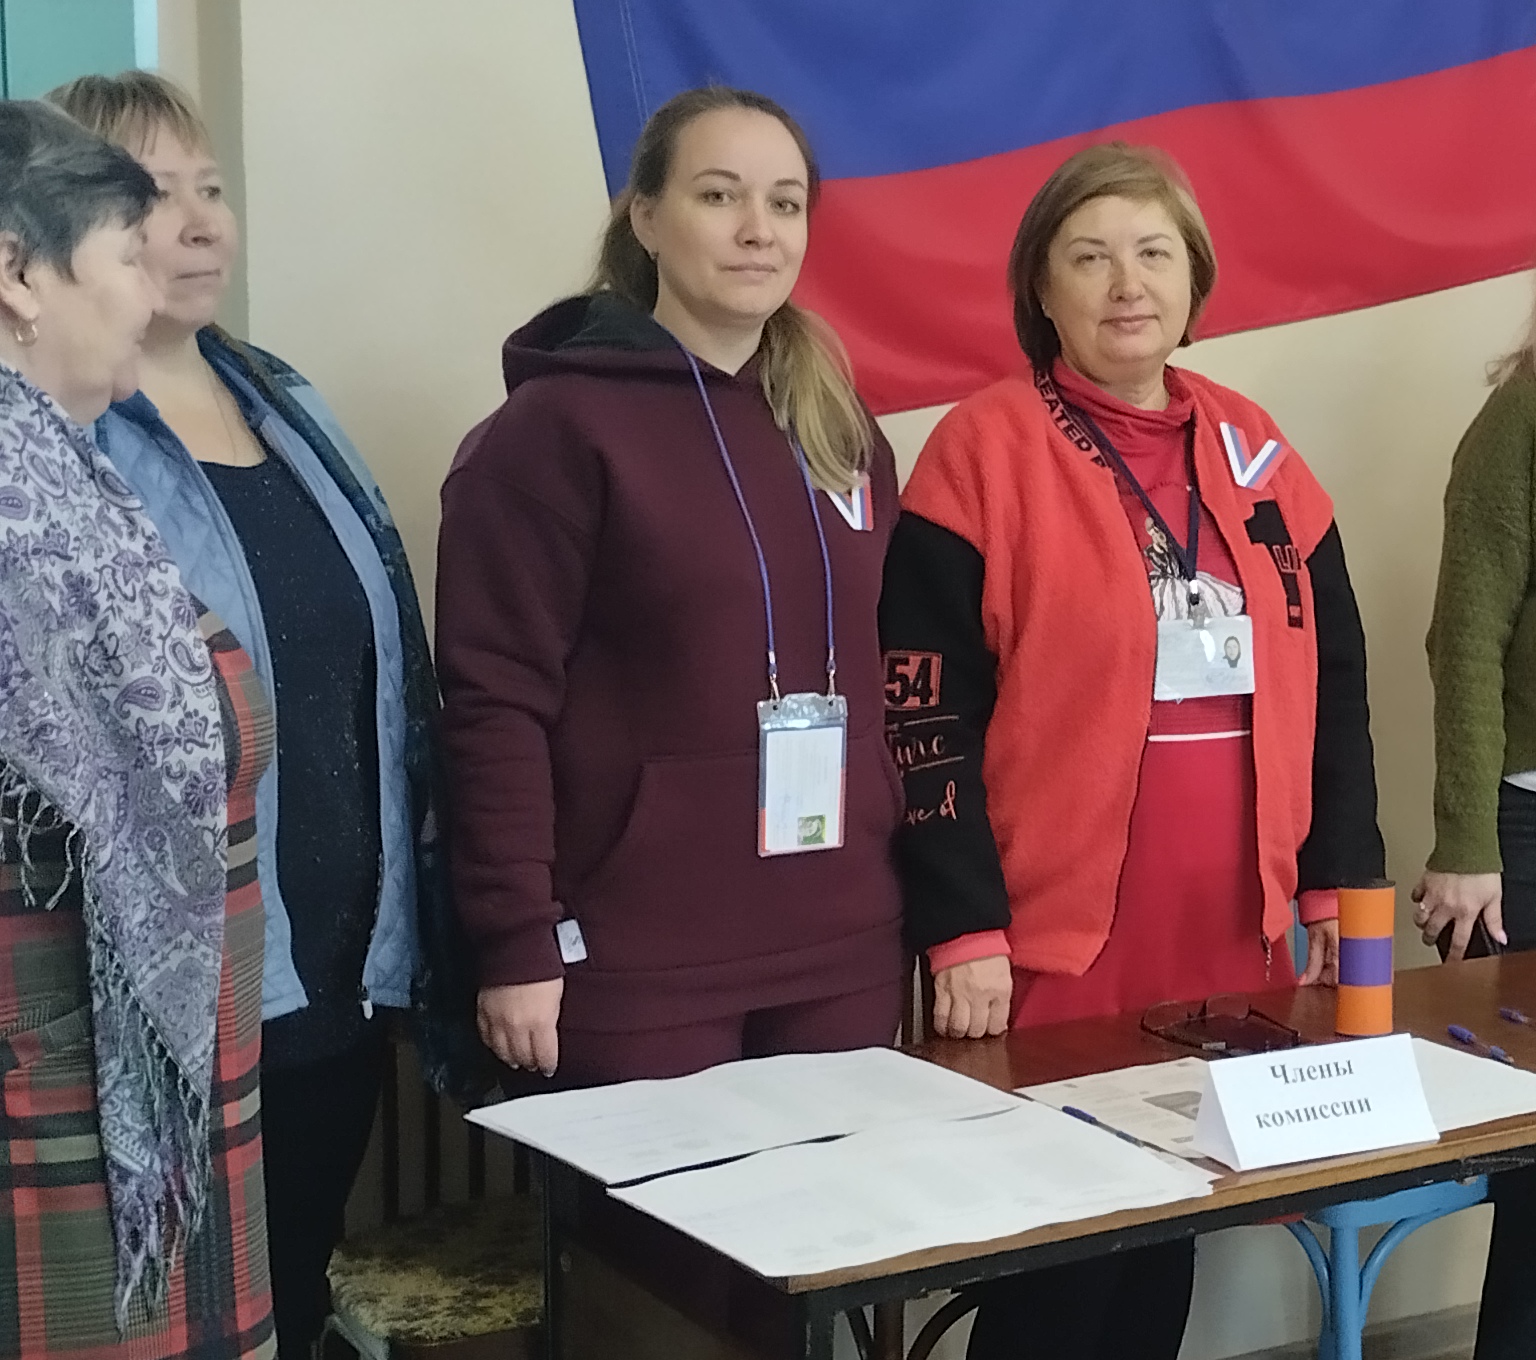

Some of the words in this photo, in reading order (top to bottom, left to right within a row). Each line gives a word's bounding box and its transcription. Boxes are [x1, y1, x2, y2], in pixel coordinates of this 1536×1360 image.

[885, 657, 934, 705] 54
[1270, 1058, 1355, 1085] Члены
[1255, 1096, 1372, 1129] комиссии
